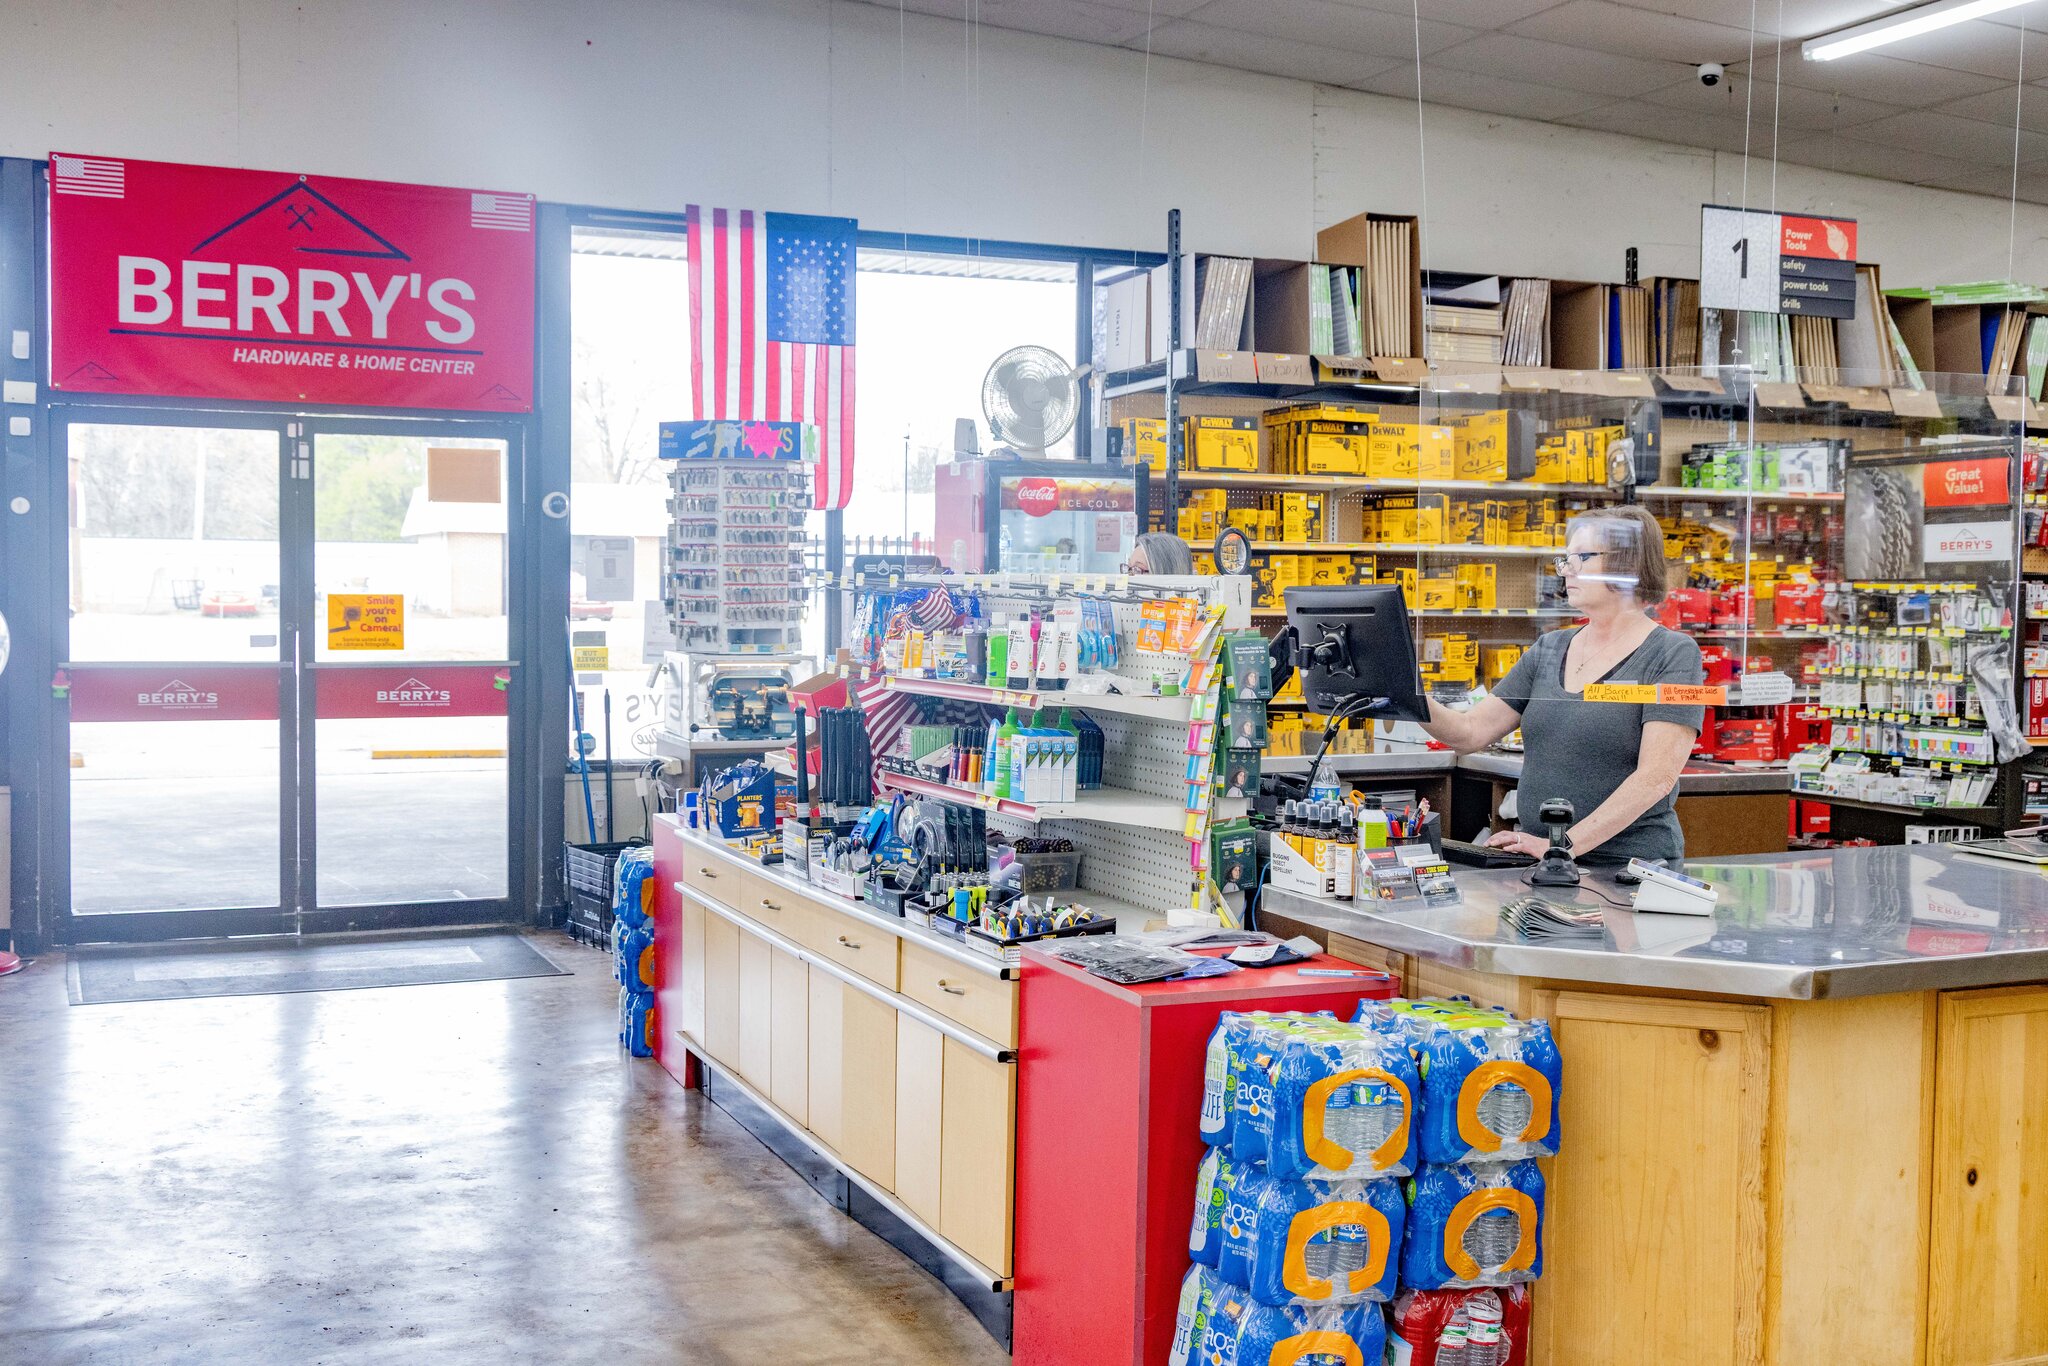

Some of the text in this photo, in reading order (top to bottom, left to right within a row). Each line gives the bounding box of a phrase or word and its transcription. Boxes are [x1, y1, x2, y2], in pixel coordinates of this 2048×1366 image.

[1785, 228, 1813, 241] Power
[1785, 240, 1807, 251] Tools
[1732, 238, 1748, 279] 1
[1782, 260, 1806, 272] safety
[1783, 281, 1829, 292] power tools
[118, 255, 476, 344] BERRY'S
[1782, 299, 1801, 309] drills
[233, 347, 475, 375] HARDWARE & HOME CENTER
[1139, 431, 1153, 441] XR
[1945, 467, 1981, 481] Great
[1945, 480, 1984, 495] Value!
[1063, 499, 1119, 508] ICE COLD
[1940, 540, 1993, 551] BERRY'S
[367, 596, 395, 605] Smile
[365, 606, 397, 616] you're
[360, 623, 401, 632] Camera!
[376, 690, 451, 701] BERRY'S
[1587, 685, 1656, 695] All Barrel Fans
[137, 692, 218, 704] BERRY'S
[737, 794, 763, 802] PLANTERS
[1272, 866, 1293, 875] REPELLENT
